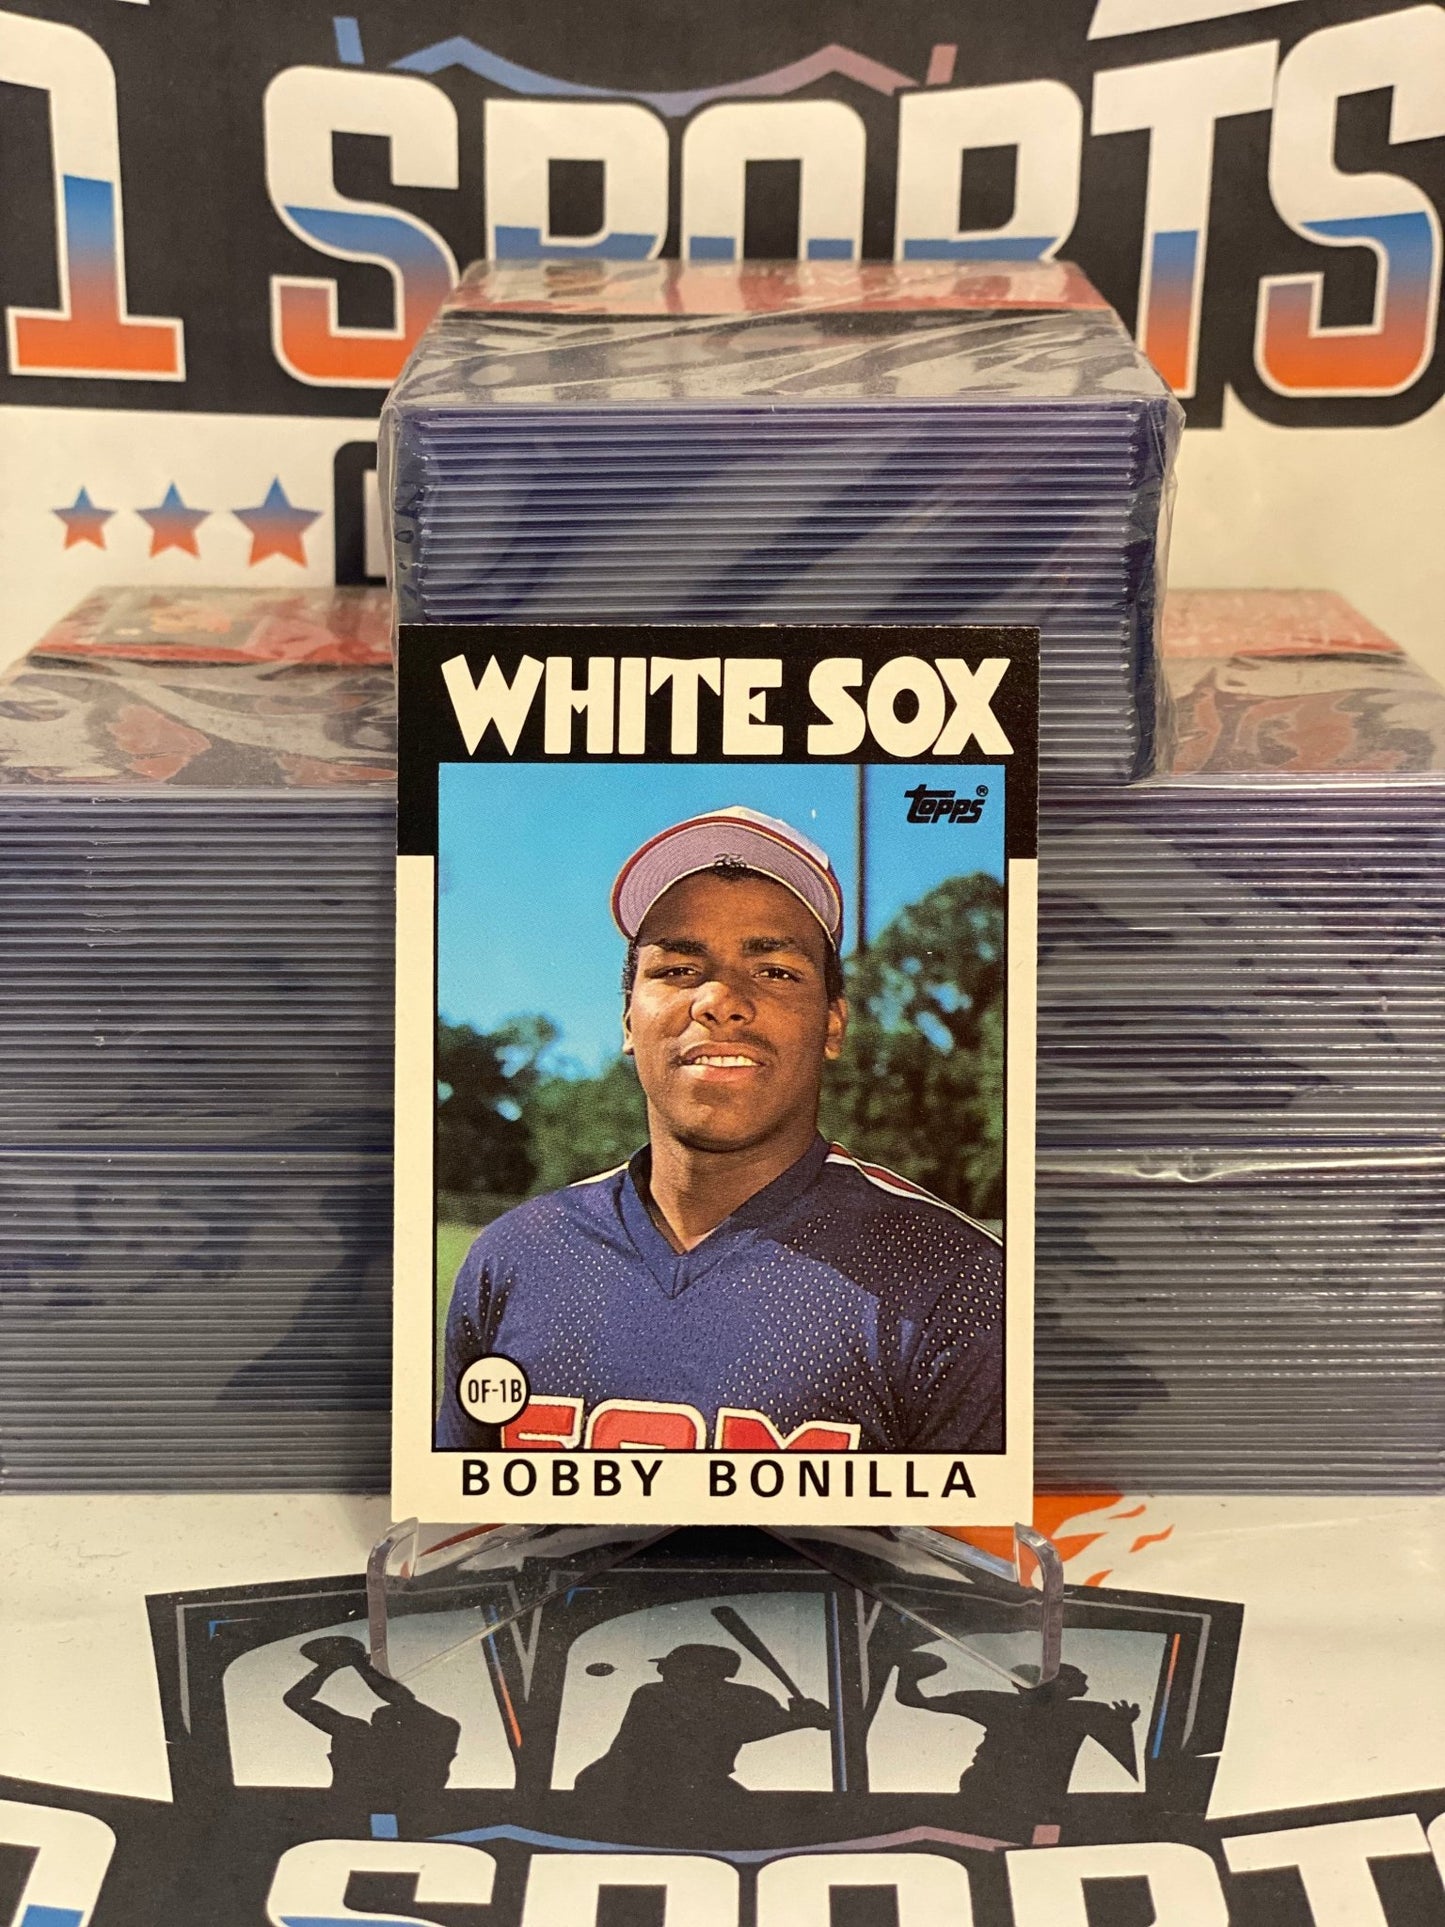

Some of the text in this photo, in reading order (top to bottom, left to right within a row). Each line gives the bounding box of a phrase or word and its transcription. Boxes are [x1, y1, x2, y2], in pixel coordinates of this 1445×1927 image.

[263, 4, 1445, 399] SPORTS
[441, 653, 1014, 758] WHITE SOX
[468, 1379, 522, 1403] OF-1B
[461, 1459, 977, 1499] BOBBY BONILLA
